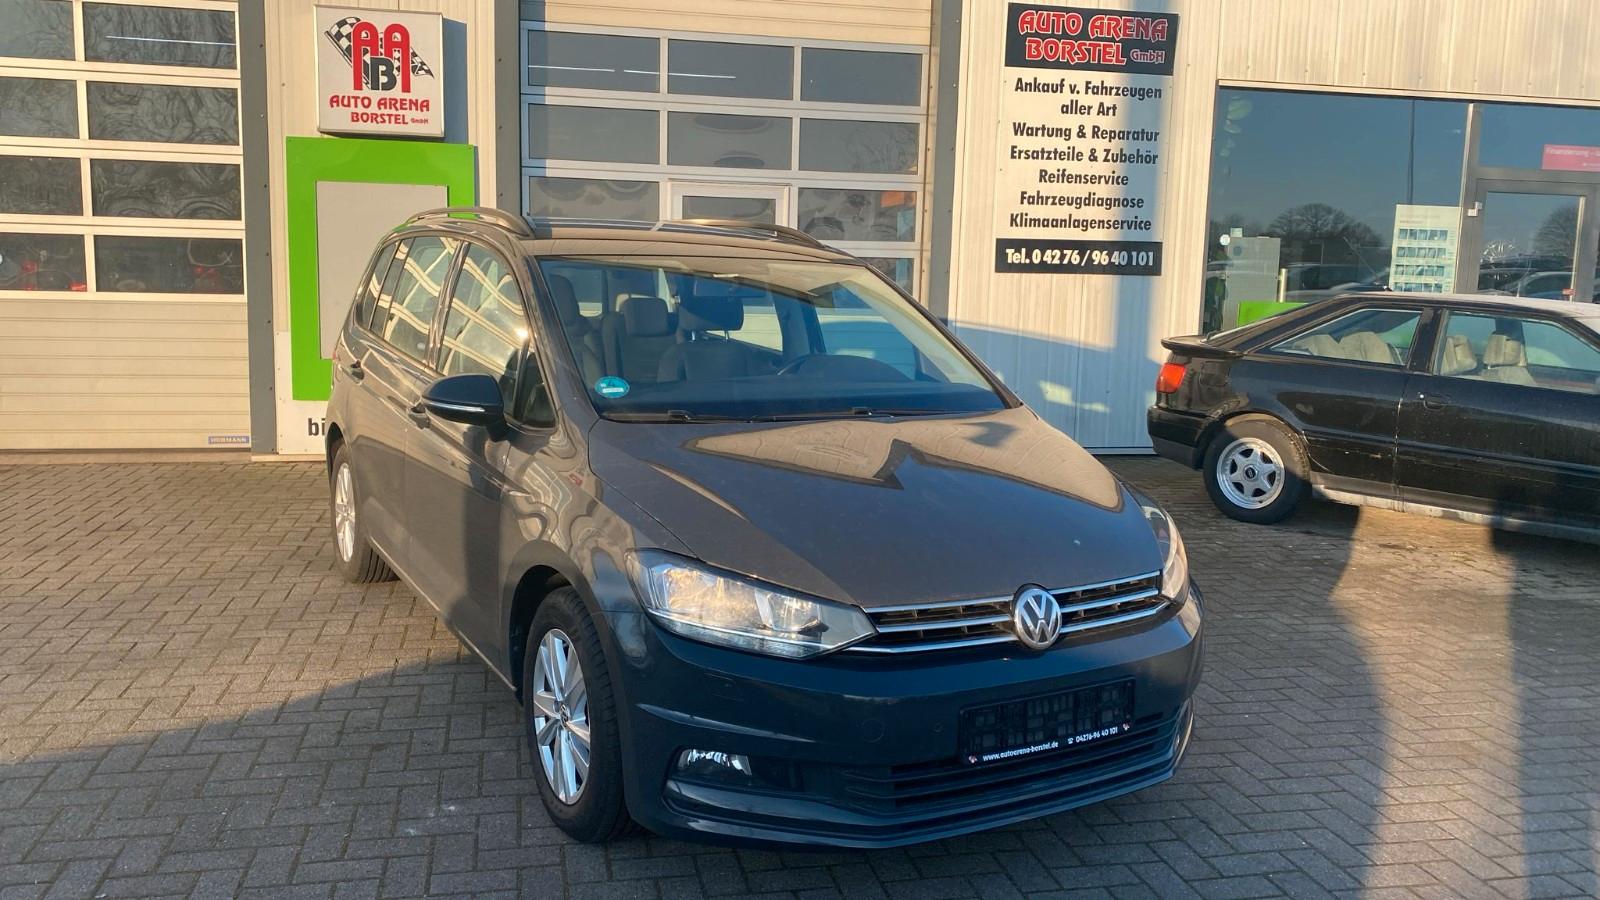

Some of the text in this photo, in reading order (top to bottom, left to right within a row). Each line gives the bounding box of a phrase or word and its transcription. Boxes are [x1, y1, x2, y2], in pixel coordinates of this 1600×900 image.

[1018, 10, 1168, 43] AUTO ARENA
[1025, 38, 1166, 65] BORSTEL GmbH
[1015, 77, 1162, 101] Ankauf v. Fahrzeugen
[329, 95, 430, 112] AUTO ARENA
[1060, 99, 1118, 117] aller Art
[351, 112, 409, 125] BORSTEL
[1012, 122, 1160, 143] Wartung & Reparatur
[1010, 145, 1159, 165] Ersatzteile & Zubehör
[1039, 169, 1129, 186] Reifenservice
[1020, 190, 1145, 211] Fahrzeugdiagnose
[1009, 213, 1152, 232] Klimaanlagenservice
